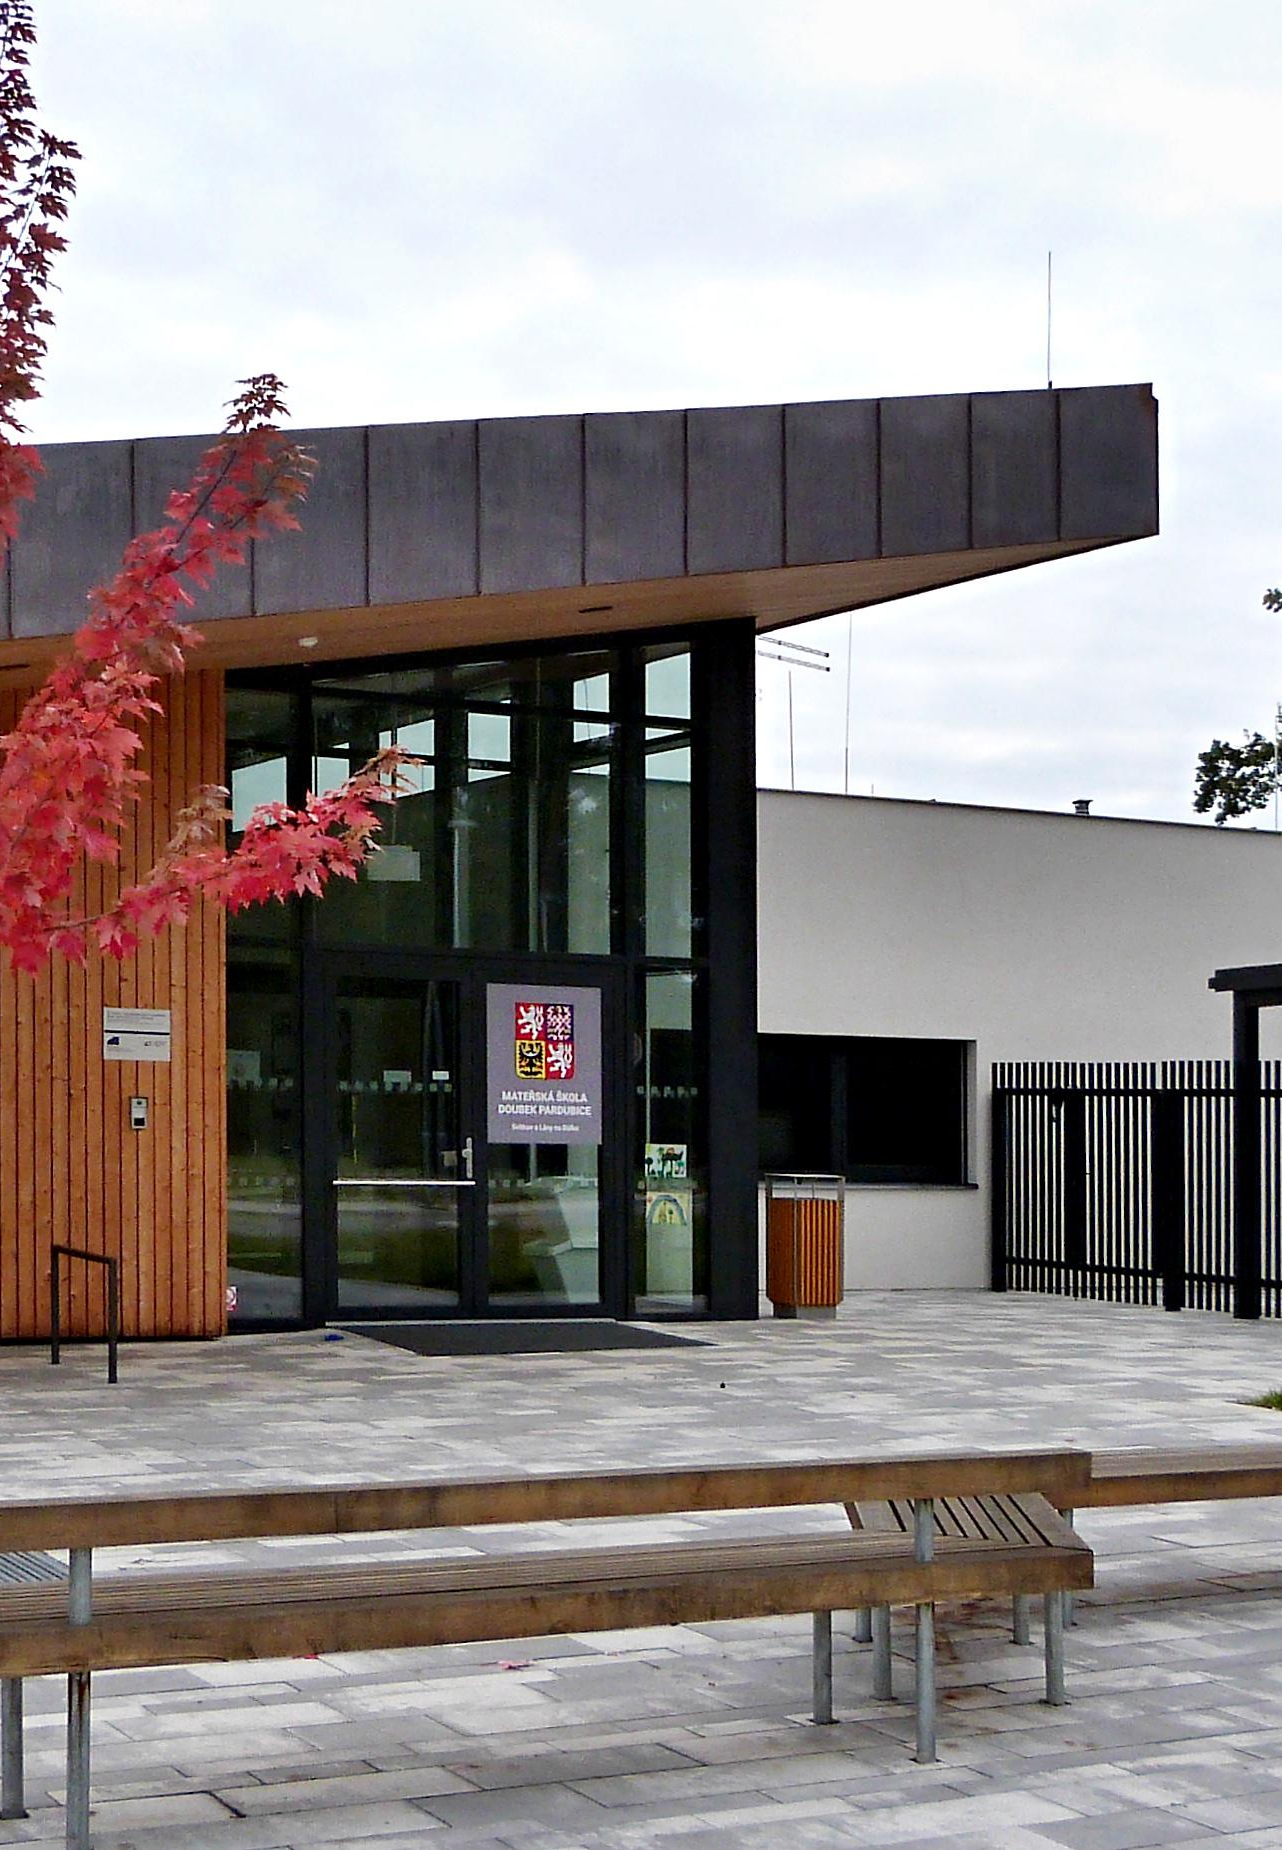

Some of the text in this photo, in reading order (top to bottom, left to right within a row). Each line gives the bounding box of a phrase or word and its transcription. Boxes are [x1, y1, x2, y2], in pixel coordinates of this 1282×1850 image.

[502, 1090, 587, 1103] MATEŘSKÁ ŠKOLA
[498, 1104, 592, 1116] DOUBEK PARDUBICE
